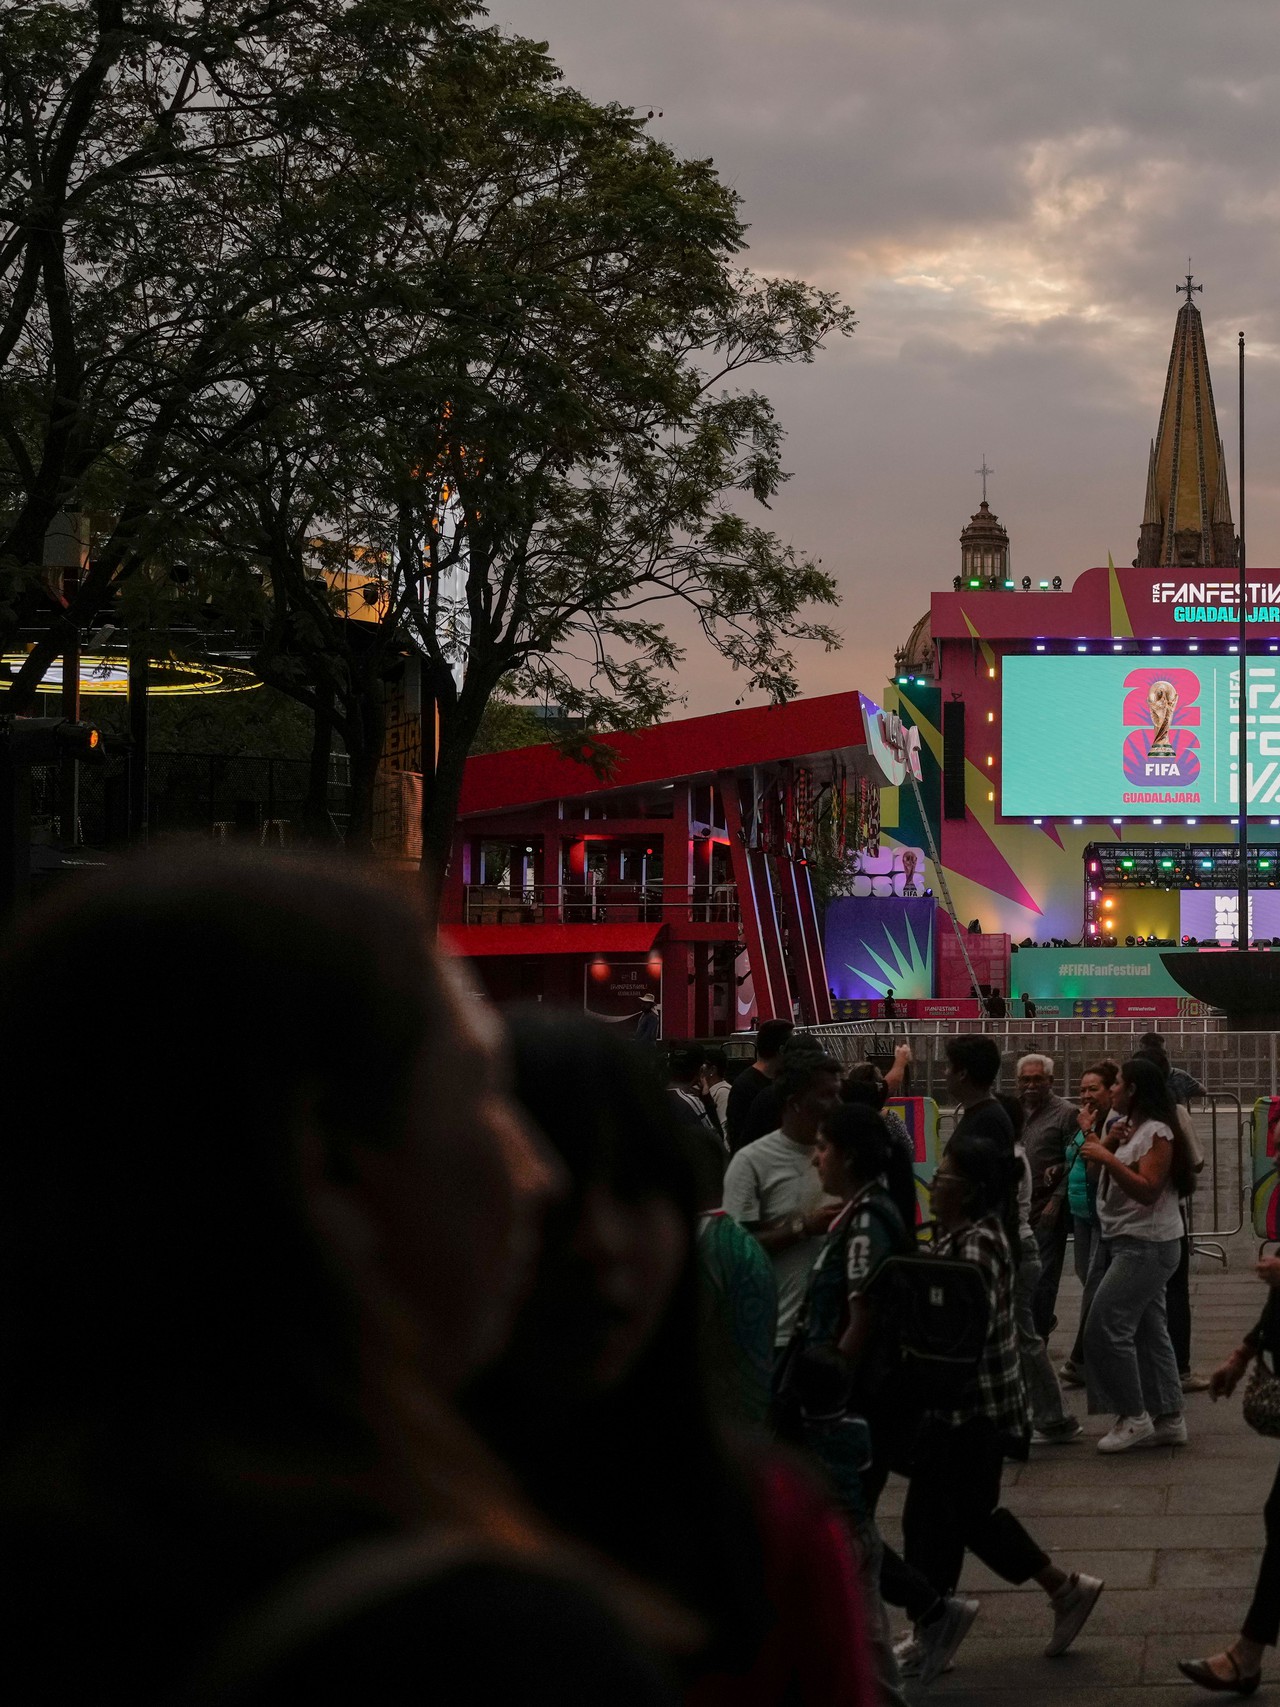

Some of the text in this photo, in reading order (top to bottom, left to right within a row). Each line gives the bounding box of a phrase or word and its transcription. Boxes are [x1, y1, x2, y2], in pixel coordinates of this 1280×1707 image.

[1152, 583, 1160, 603] FIFA
[1145, 763, 1180, 776] FIFA
[1123, 792, 1200, 804] GUADALAJARA
[1059, 963, 1151, 976] #FIFAFanFestival
